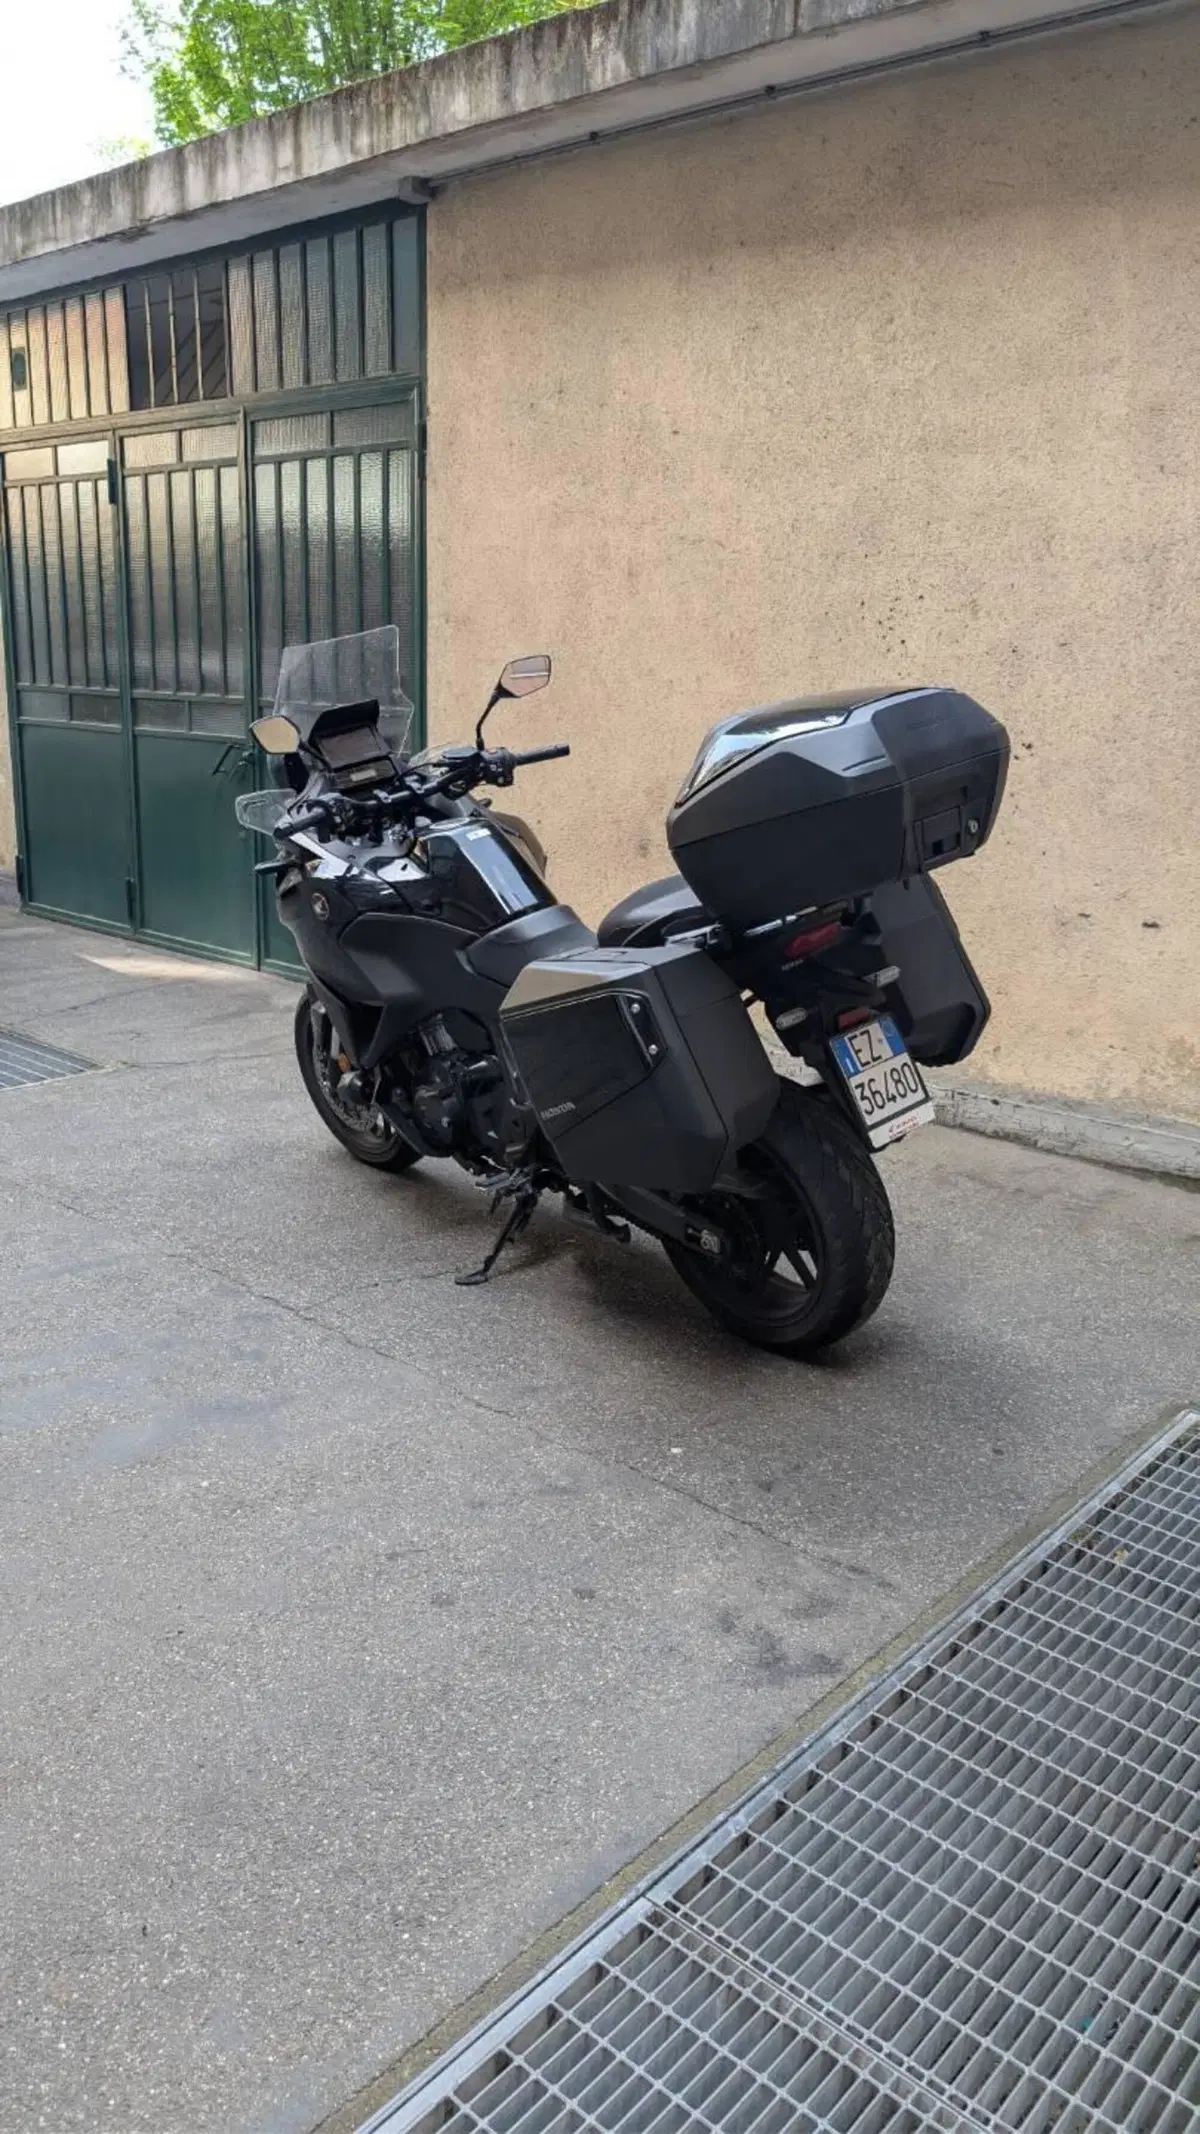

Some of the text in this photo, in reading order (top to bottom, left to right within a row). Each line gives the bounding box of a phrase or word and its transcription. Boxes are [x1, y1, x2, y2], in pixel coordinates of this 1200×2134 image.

[848, 1030, 882, 1067] EZ
[854, 1062, 919, 1115] 36480
[540, 1102, 577, 1120] HONDA
